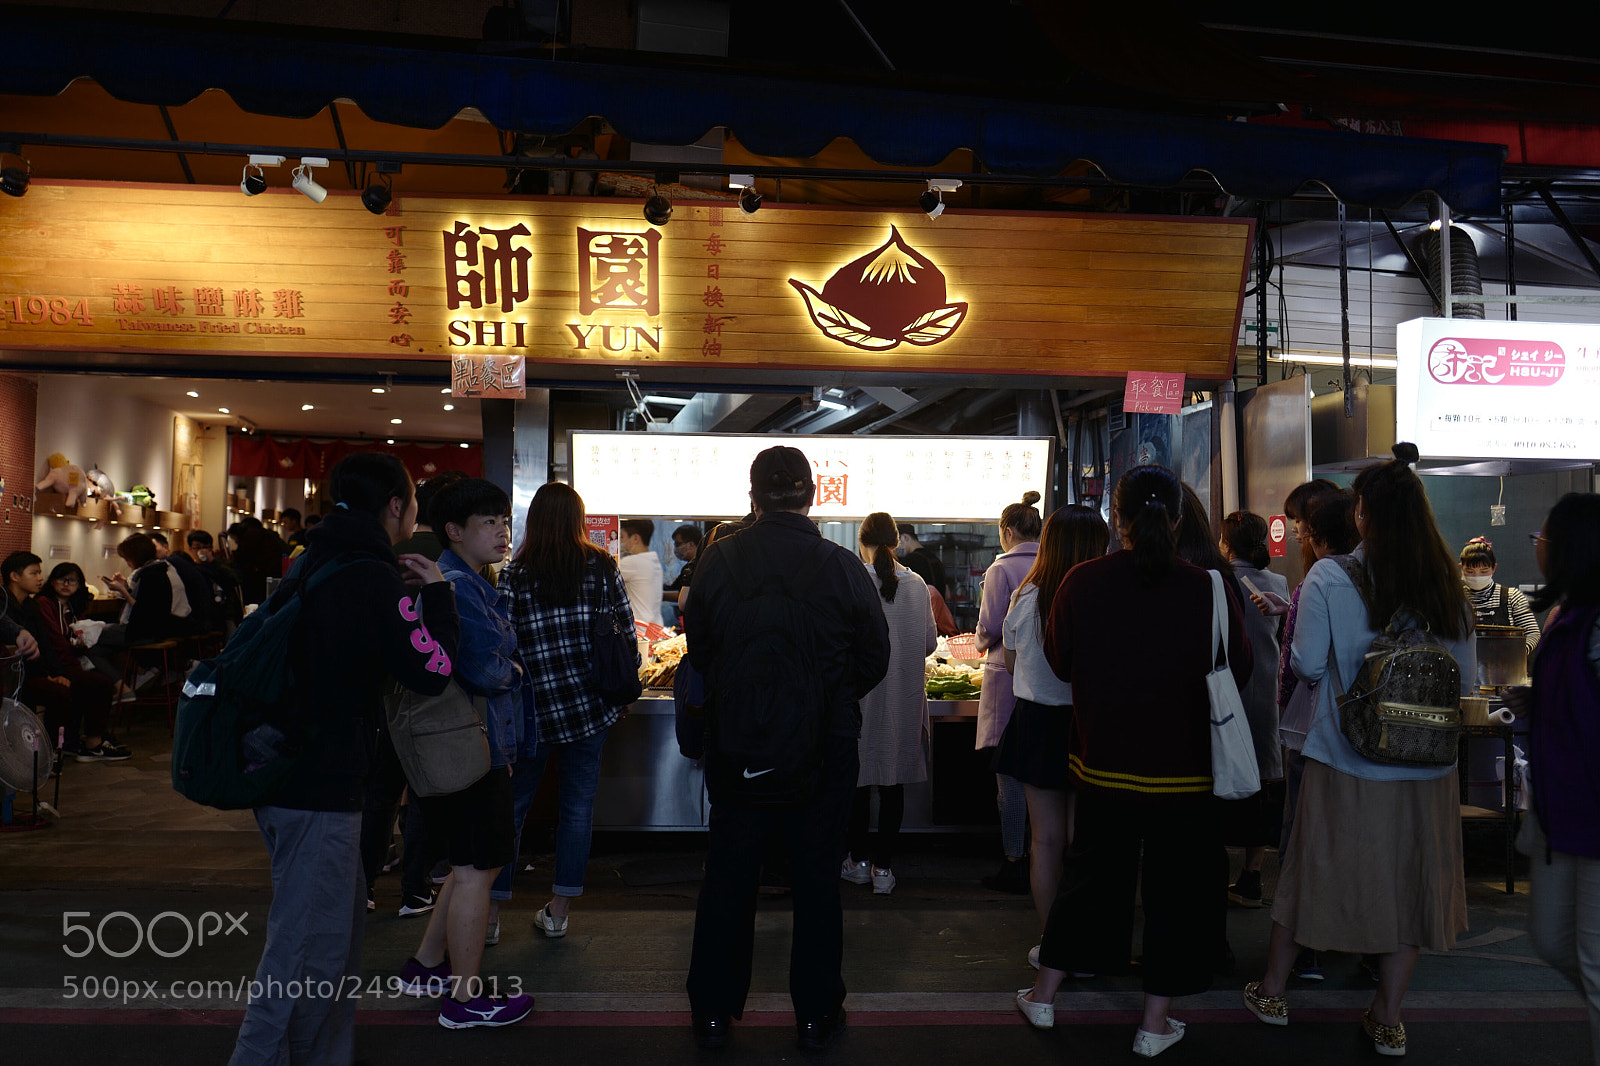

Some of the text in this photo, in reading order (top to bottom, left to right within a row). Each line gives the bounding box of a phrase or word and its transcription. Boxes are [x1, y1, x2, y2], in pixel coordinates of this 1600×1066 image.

[111, 284, 303, 318] 蒜味鹽酥雞
[383, 225, 413, 346] 可靠而安心
[702, 233, 726, 357] 每日換新油
[116, 318, 305, 335] Taiwanese Fried Chicken
[448, 320, 662, 352] SHI YUN
[453, 358, 520, 391] 點餐區
[1510, 366, 1559, 377] HSU-JI
